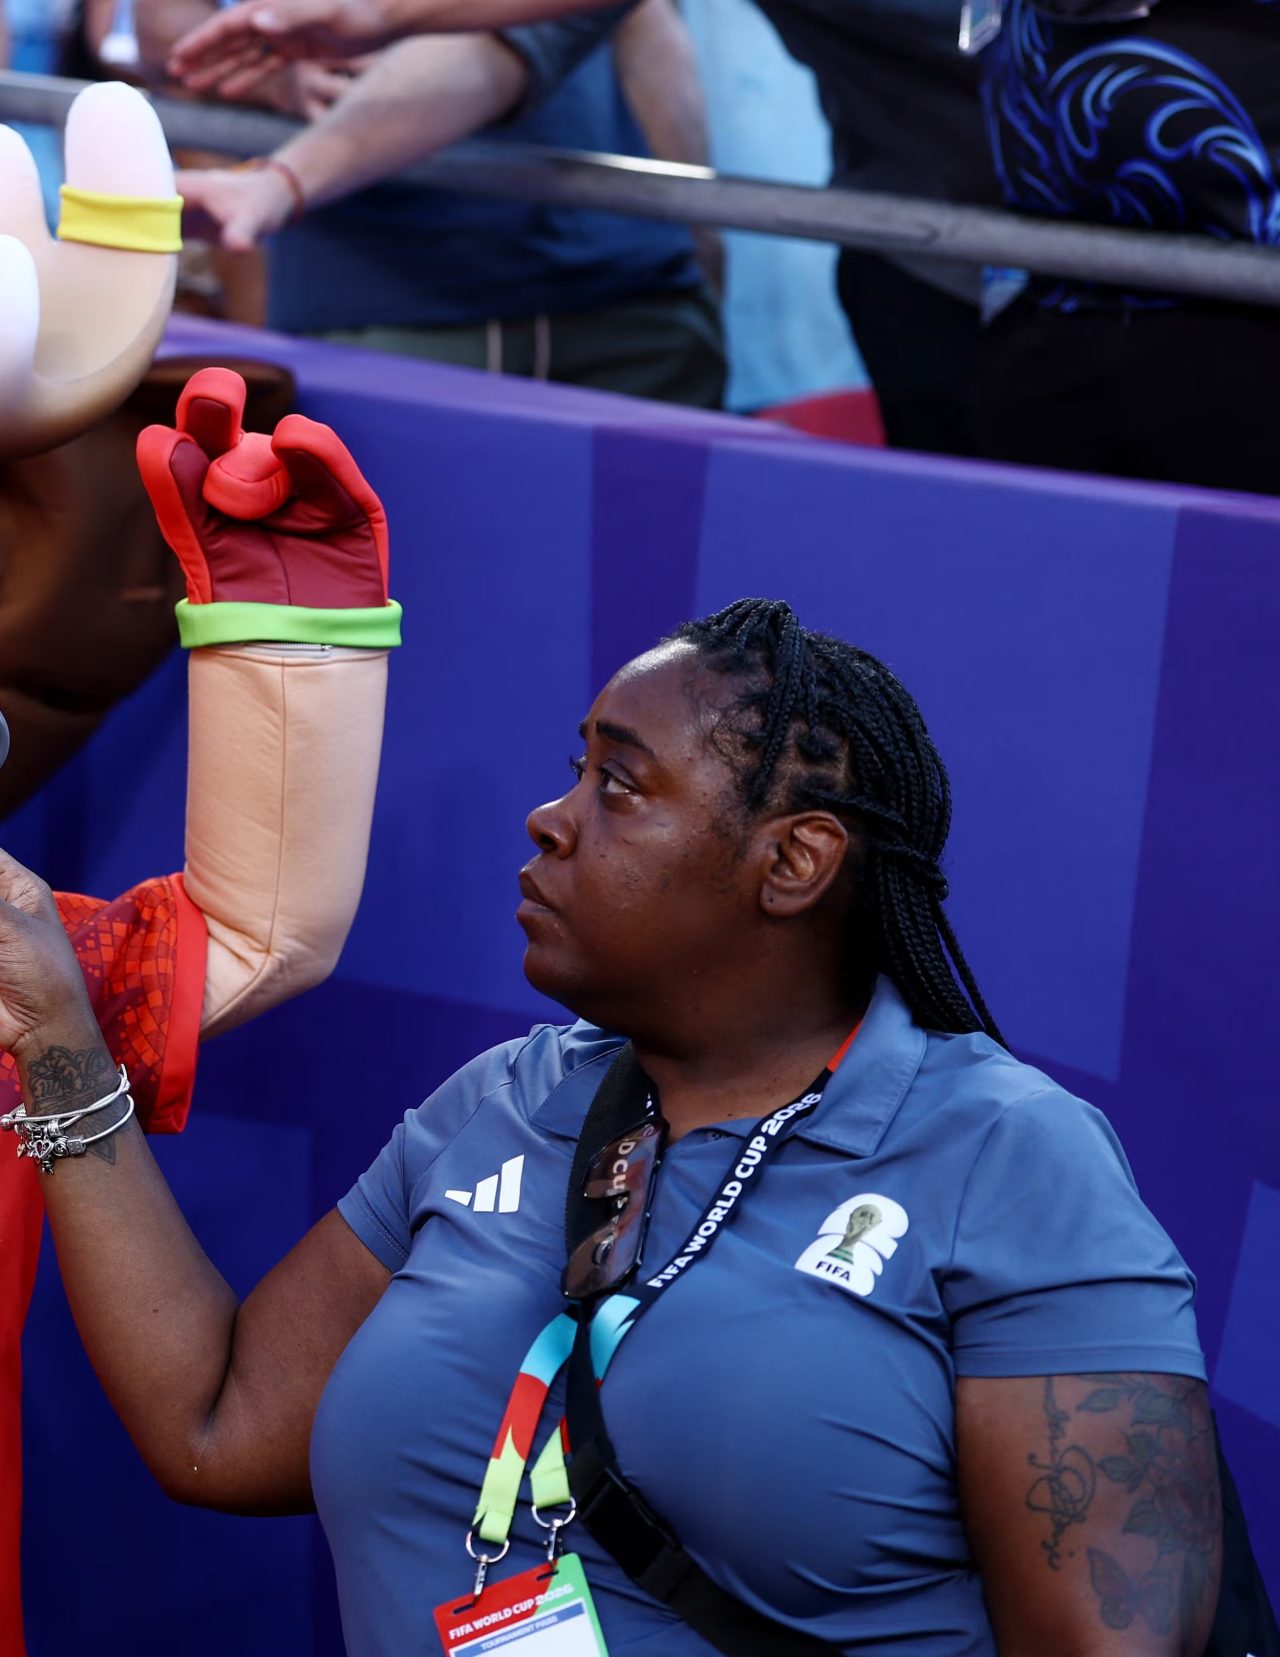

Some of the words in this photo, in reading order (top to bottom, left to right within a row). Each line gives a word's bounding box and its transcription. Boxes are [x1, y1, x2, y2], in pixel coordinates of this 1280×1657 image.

[646, 1254, 694, 1288] FIFA
[683, 1180, 743, 1253] WORLD
[734, 1135, 768, 1179] CUP
[760, 1092, 822, 1136] 2026
[815, 1260, 851, 1281] FIFA
[448, 1624, 474, 1640] FIFA
[472, 1607, 513, 1631] WORLD
[511, 1597, 536, 1615] CUP
